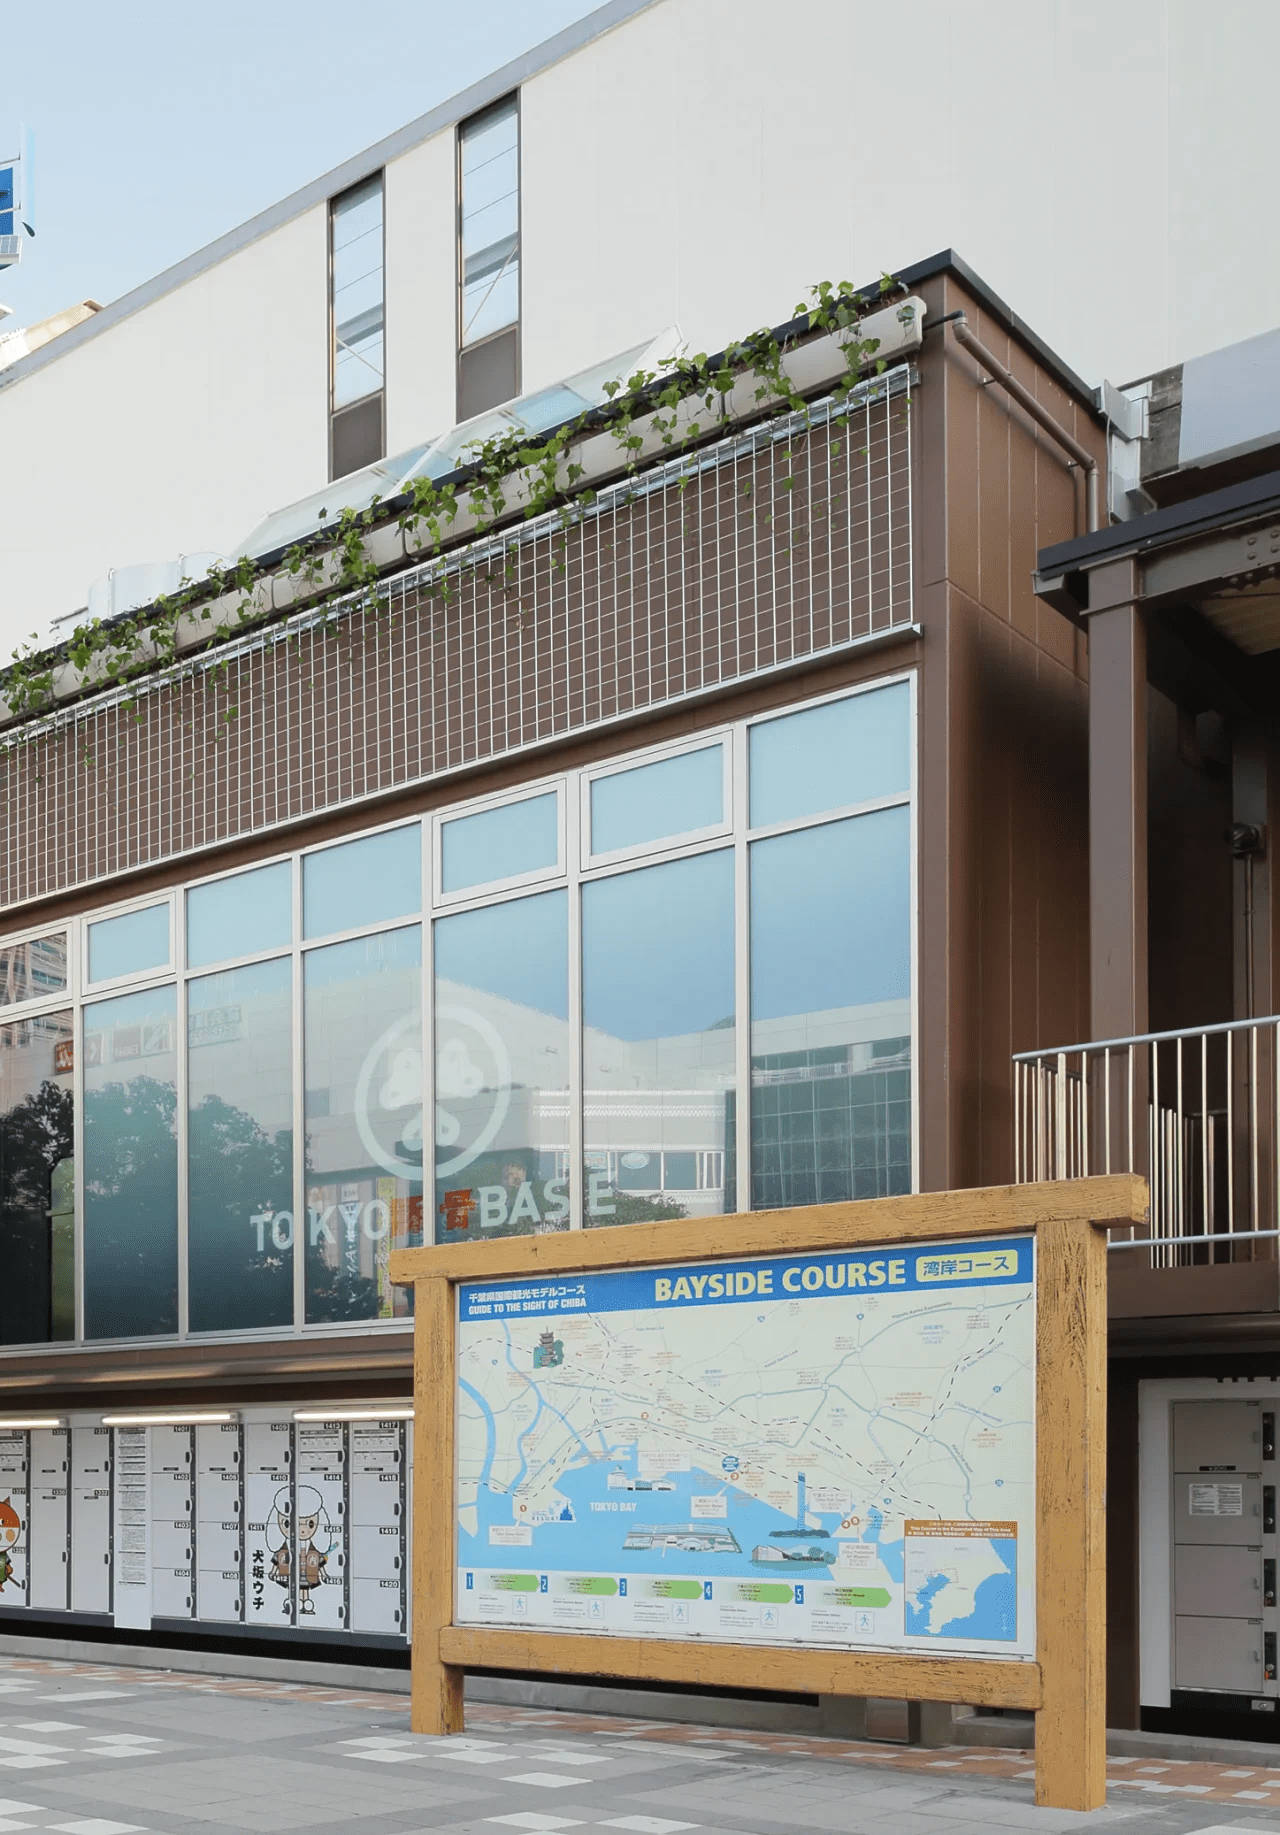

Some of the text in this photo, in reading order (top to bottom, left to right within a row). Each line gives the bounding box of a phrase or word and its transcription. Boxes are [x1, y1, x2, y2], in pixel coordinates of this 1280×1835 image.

[250, 1199, 389, 1253] TOKYO
[477, 1171, 617, 1228] BASE
[655, 1259, 906, 1301] BAYSIDE COURSE
[923, 1256, 1010, 1277] 湾岸コース
[469, 1298, 586, 1315] GUIDE TO THE SIGHT OF CHIBA
[590, 1502, 637, 1512] TOKYO BAY
[252, 1549, 265, 1611] 犬坂ウチ
